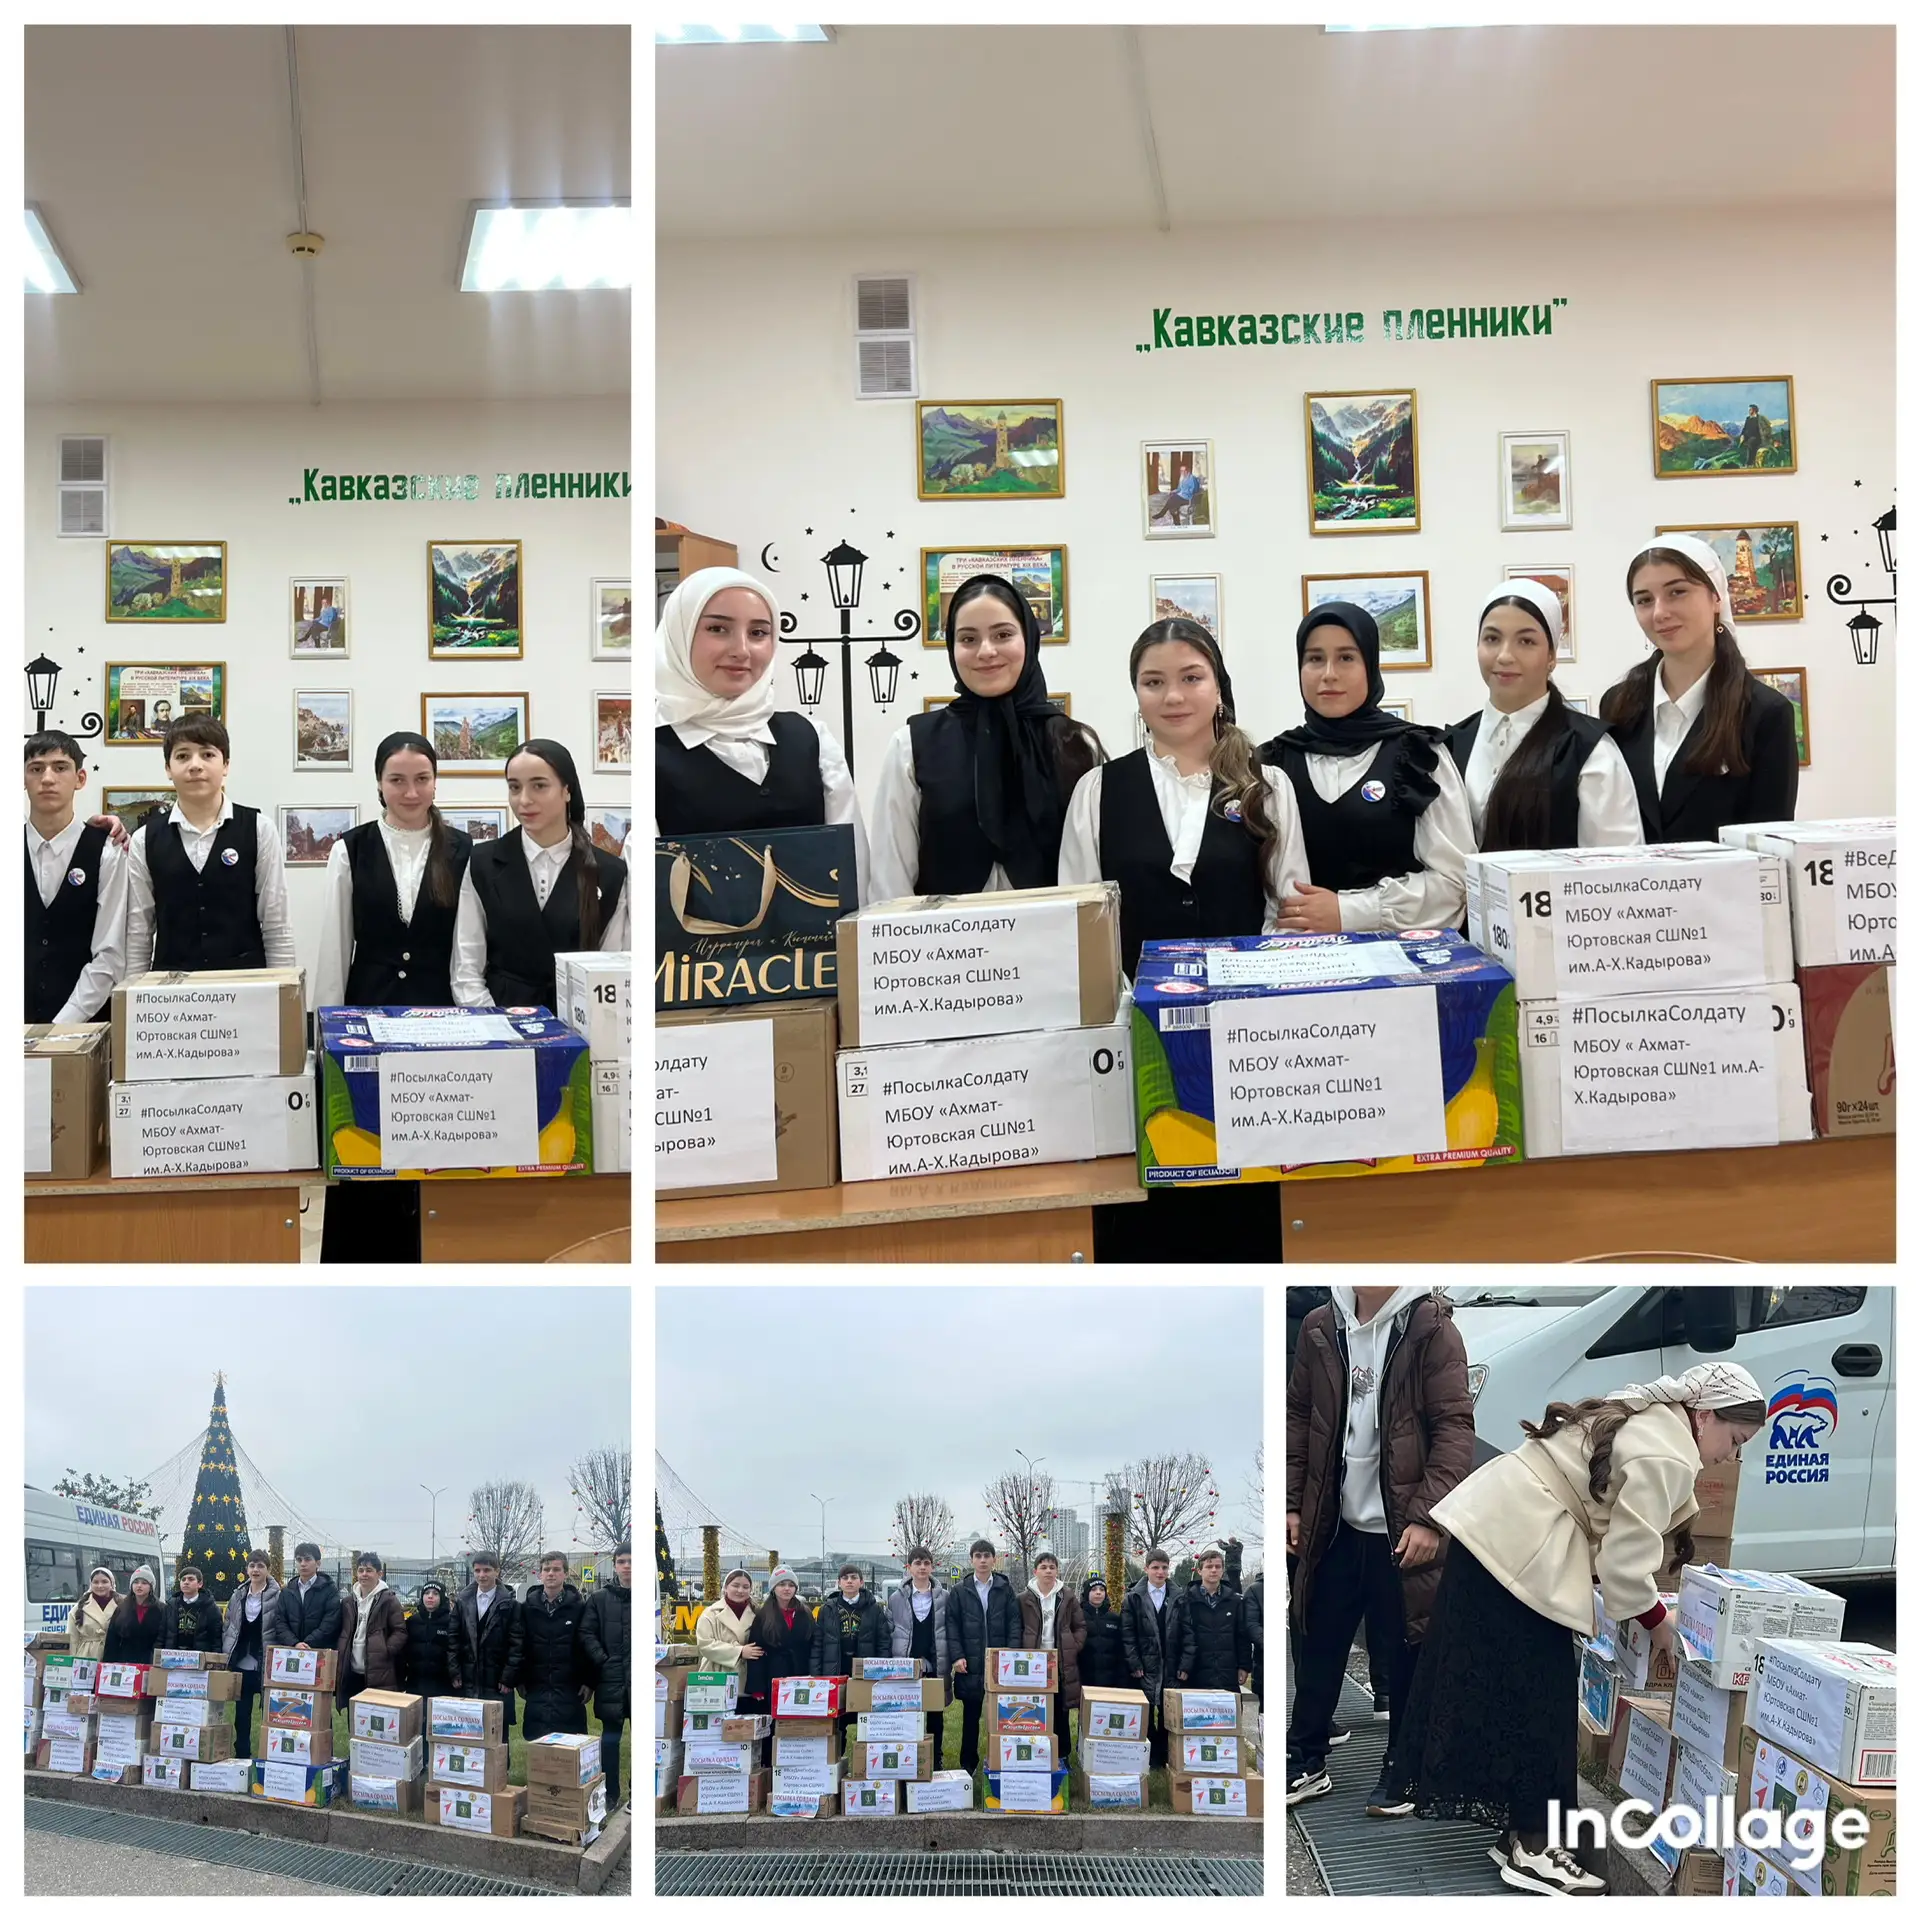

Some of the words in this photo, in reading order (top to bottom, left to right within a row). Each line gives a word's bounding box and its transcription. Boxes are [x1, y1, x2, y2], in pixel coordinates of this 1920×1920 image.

[1803, 859, 1834, 886] 18
[1563, 876, 1702, 897] #ПосылкаСолдату
[1518, 890, 1551, 918] 18
[1565, 907, 1612, 923] МБОУ
[1616, 905, 1678, 921] «Ахмат-
[872, 916, 1016, 938] #ПосылкаСолдату
[1566, 931, 1653, 950] Юртовская
[1655, 926, 1708, 944] СШ№1
[872, 949, 921, 965] МБОУ
[926, 945, 990, 961] «Ахмат-
[1567, 953, 1712, 974] им.А-Х.Кадырова»
[873, 973, 961, 992] Юртовская
[966, 966, 1021, 983] СШ№1
[136, 991, 236, 1005] #ПосылкаСолдату
[593, 984, 616, 1003] 18
[874, 993, 1023, 1016] им.А-Х.Кадырова»
[136, 1012, 170, 1024] МБОУ
[173, 1012, 218, 1023] «Ахмат-
[1535, 1014, 1553, 1026] 4,9
[1572, 1004, 1746, 1025] #ПосылкаСолдату
[136, 1030, 197, 1043] Юртовская
[199, 1028, 239, 1041] СШ№1
[1227, 1021, 1377, 1044] #ПосылкаСолдату
[1534, 1033, 1547, 1044] 16
[136, 1048, 240, 1060] им.А-Х.Кадырова»
[1573, 1039, 1621, 1054] МБОУ
[1638, 1038, 1690, 1052] Ахмат-
[1228, 1056, 1279, 1073] МБОУ
[1285, 1054, 1350, 1070] «Ахмат-
[1573, 1065, 1659, 1082] Юртовская
[1663, 1061, 1716, 1077] СШ№1
[1721, 1059, 1764, 1074] им.А-
[390, 1071, 493, 1085] #ПосылкаСолдату
[883, 1067, 1029, 1096] #ПосылкаСолдату
[391, 1092, 425, 1104] МБОУ
[428, 1091, 474, 1103] «Ахмат-
[851, 1084, 864, 1094] 27
[1229, 1082, 1321, 1103] Юртовская
[1325, 1077, 1383, 1094] СШ№1
[1574, 1090, 1677, 1105] Х.Кадырова»
[119, 1108, 129, 1116] 27
[141, 1103, 243, 1119] #ПосылкаСолдату
[391, 1111, 454, 1124] Юртовская
[457, 1110, 496, 1122] СШ№1
[655, 1107, 713, 1126] СШ№1
[885, 1105, 934, 1124] МБОУ
[939, 1100, 1003, 1118] «Ахмат-
[1230, 1106, 1386, 1129] им.А-Х.Кадырова»
[141, 1126, 177, 1138] МБОУ
[179, 1125, 225, 1136] «Ахмат-
[391, 1130, 498, 1142] им.А-Х.Кадырова»
[887, 1126, 976, 1150] Юртовская
[980, 1118, 1036, 1138] СШ№1
[142, 1144, 205, 1157] Юртовская
[207, 1139, 247, 1152] СШ№1
[1416, 1153, 1441, 1163] EXTRA
[1442, 1150, 1479, 1160] PREMIUM
[1480, 1146, 1512, 1157] QUALITY
[143, 1158, 249, 1175] им.А-Х.Кадырова»
[888, 1146, 1039, 1175] им.А-Х.Кадырова»
[1148, 1170, 1185, 1178] PRODUCT
[1198, 1167, 1237, 1177] ECUADOR
[1765, 1453, 1829, 1469] ЕДИНАЯ
[1765, 1468, 1829, 1484] РОССИЯ
[76, 1505, 121, 1529] ЕДИНАЯ
[121, 1515, 156, 1538] РОССИЯ
[1753, 1653, 1765, 1675] 18
[1768, 1655, 1822, 1690] #ПосылкаСолдату
[1766, 1673, 1785, 1691] МБОУ
[1785, 1682, 1808, 1702] «Ахмат-
[1763, 1691, 1796, 1716] Юртовская
[1796, 1708, 1819, 1728] СШ№1
[1759, 1710, 1817, 1746] им.А-Х.Кадырова»
